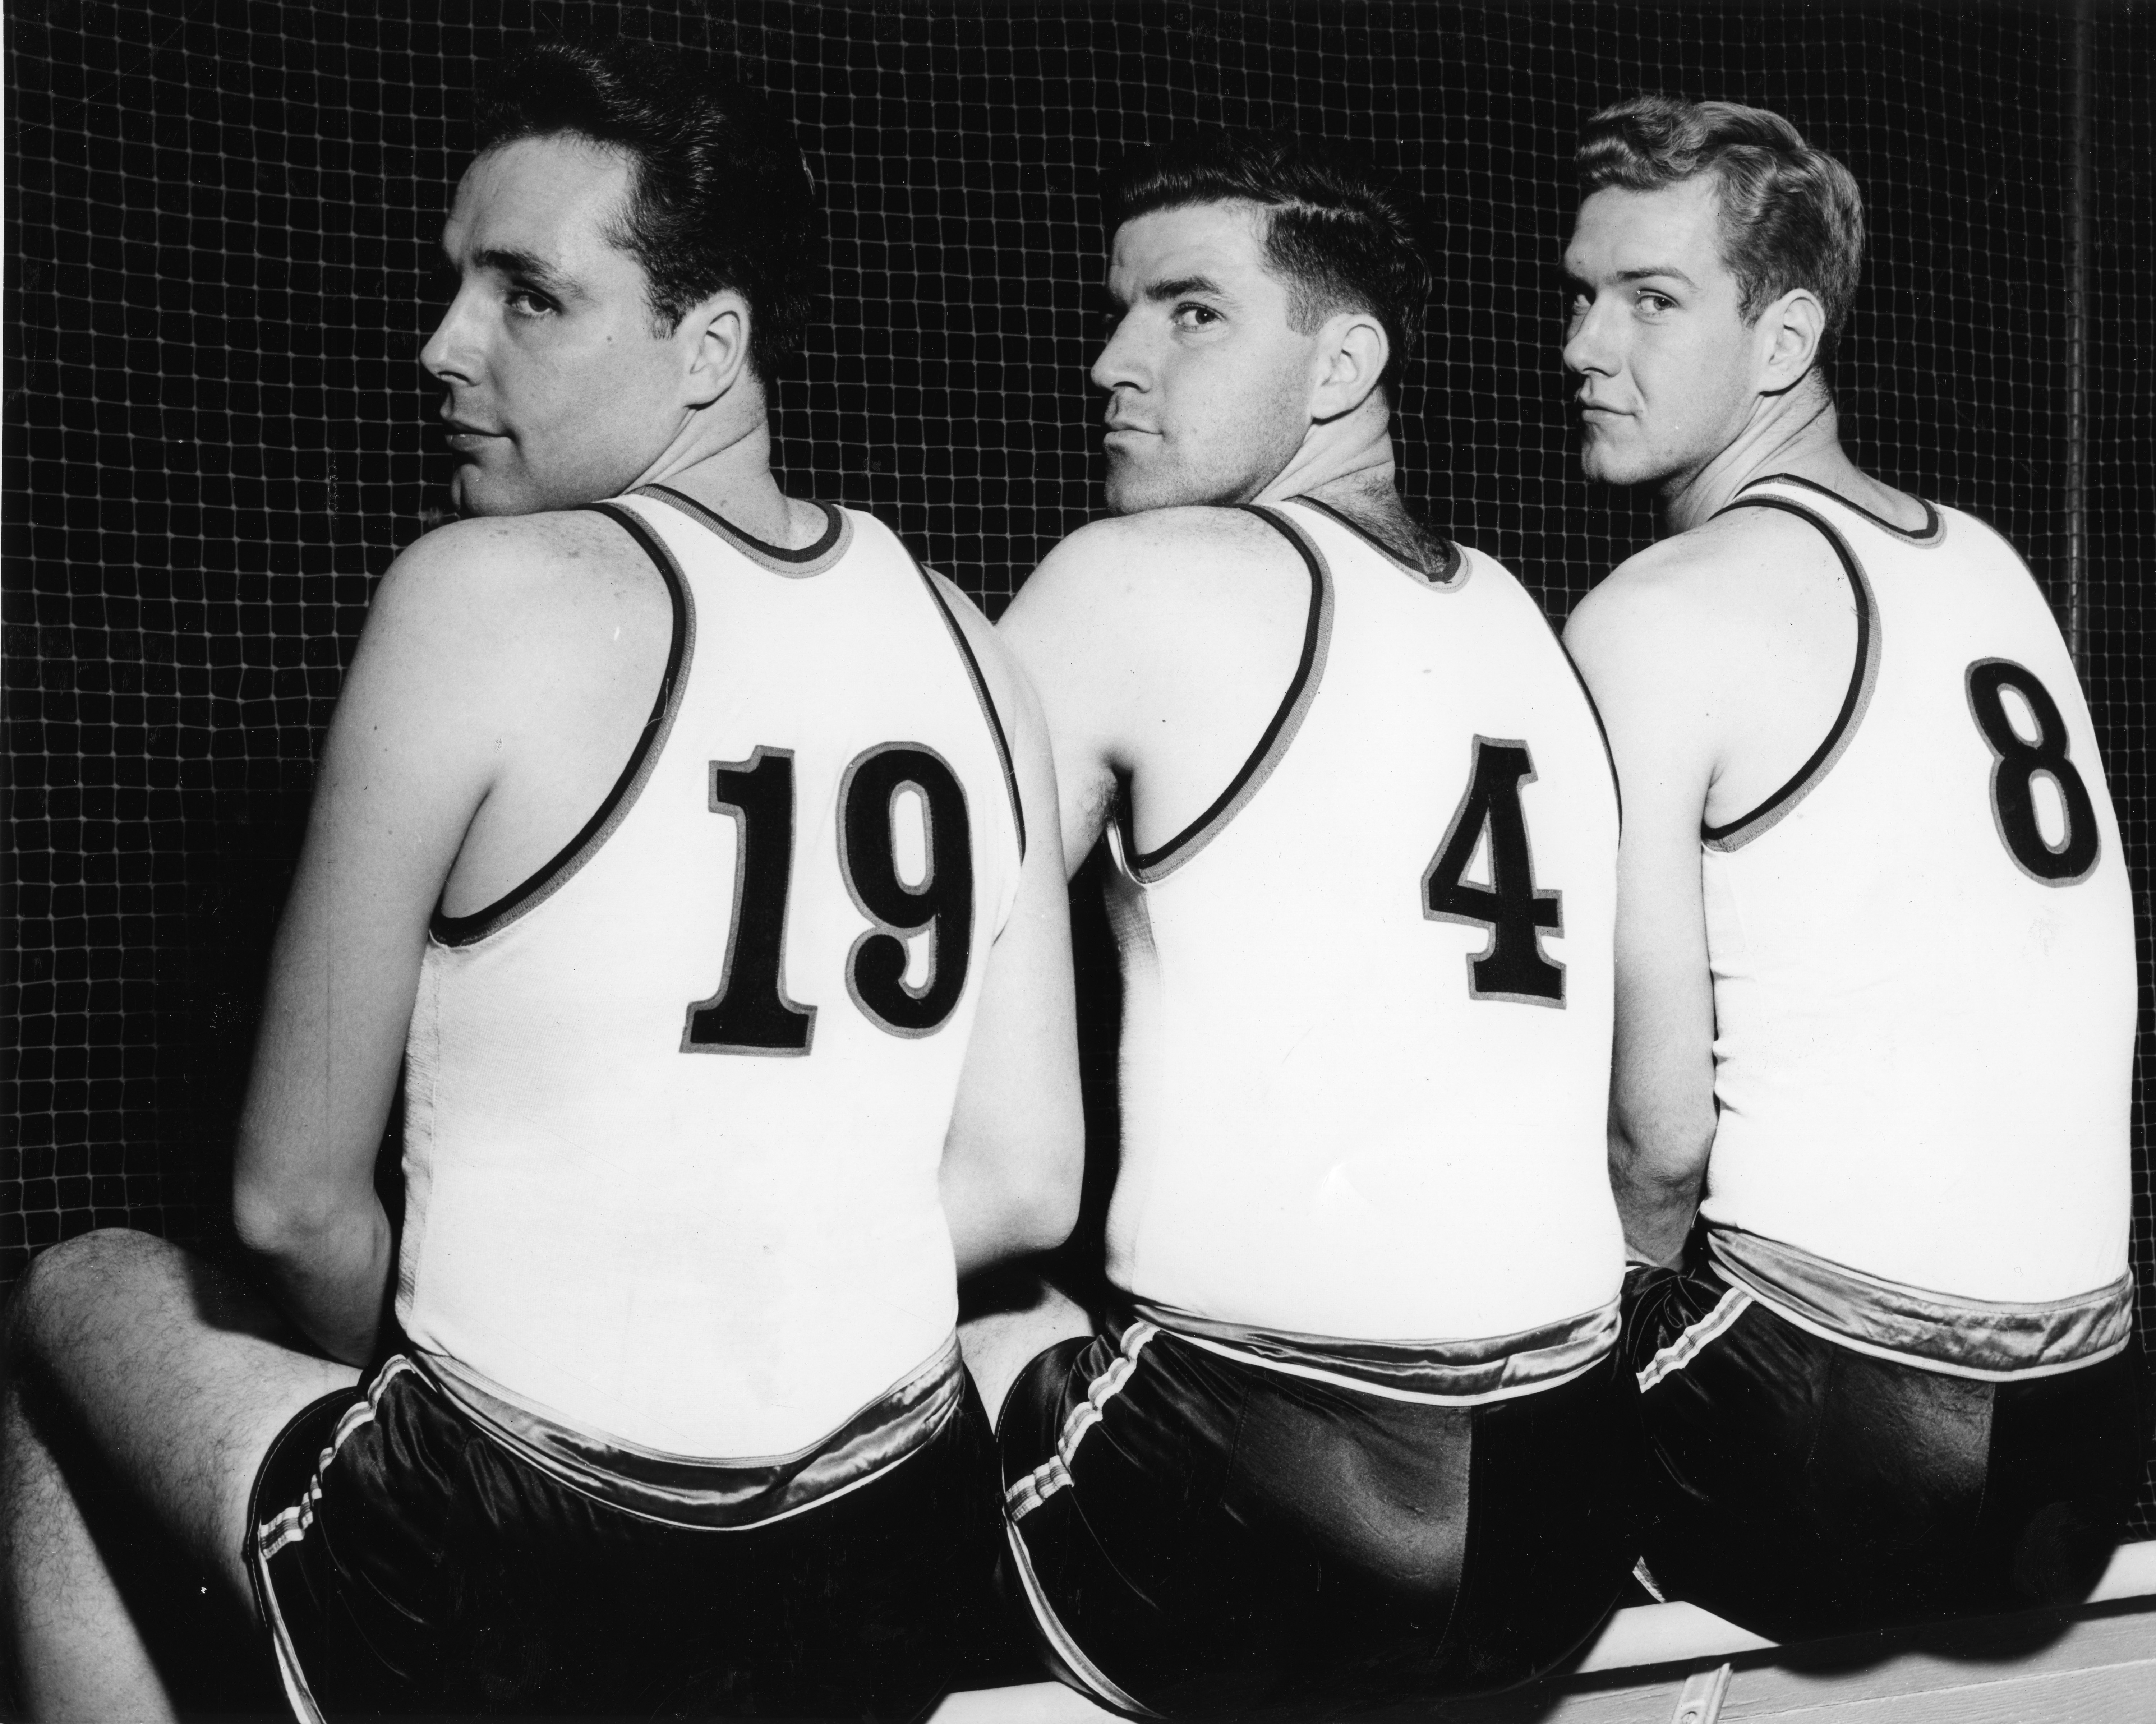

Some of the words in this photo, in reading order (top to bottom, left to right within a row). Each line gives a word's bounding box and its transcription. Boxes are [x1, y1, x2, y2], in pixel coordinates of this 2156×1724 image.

[679, 741, 976, 1058] 19
[1420, 734, 1566, 1010] 4
[1964, 657, 2101, 888] 8
